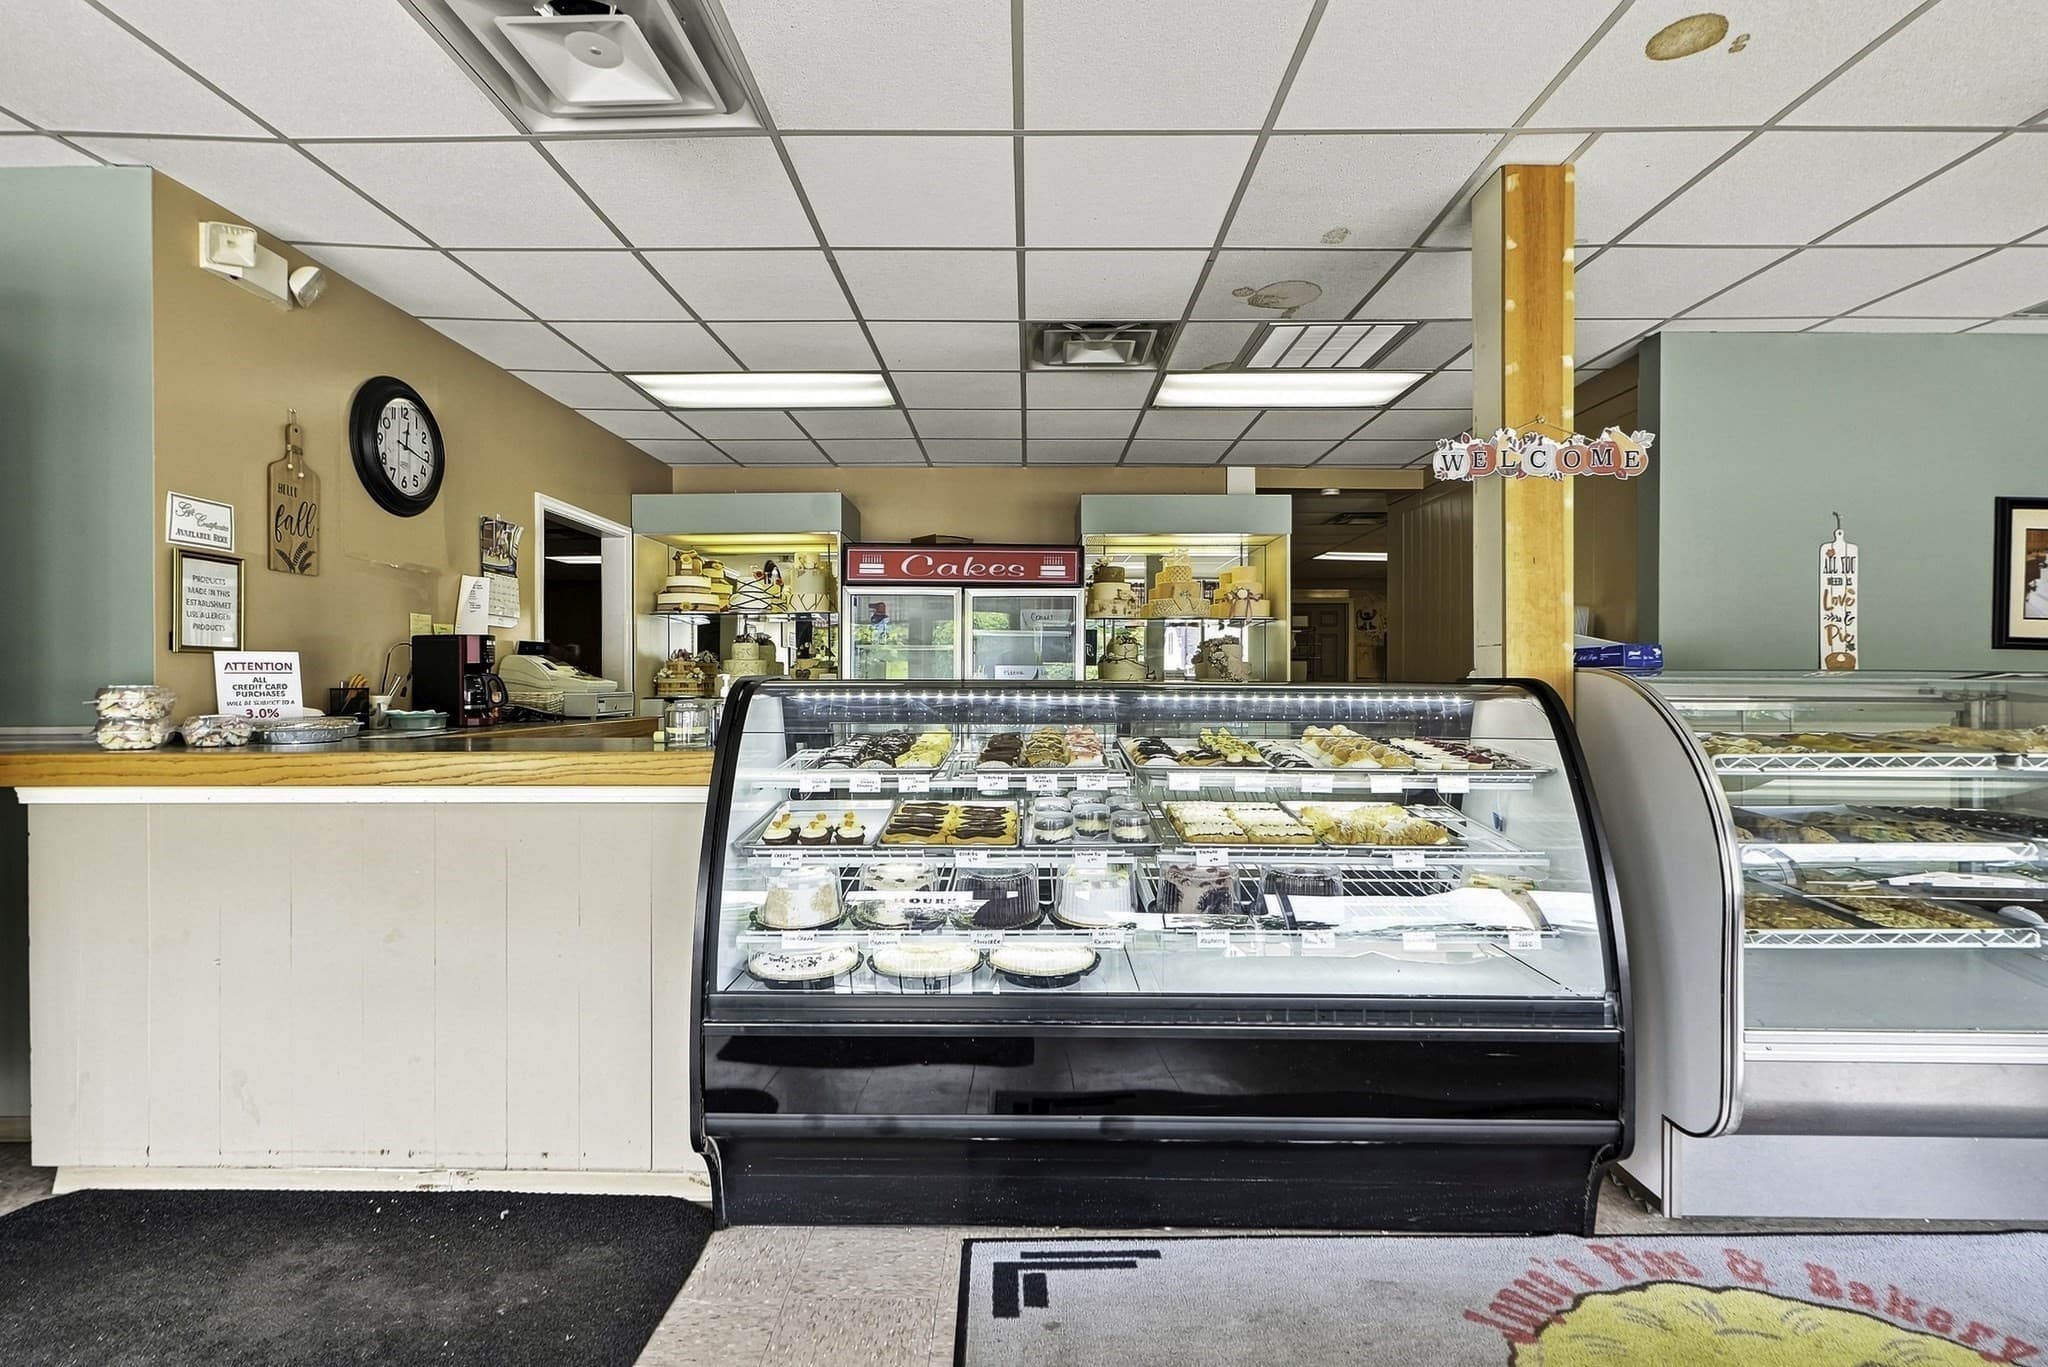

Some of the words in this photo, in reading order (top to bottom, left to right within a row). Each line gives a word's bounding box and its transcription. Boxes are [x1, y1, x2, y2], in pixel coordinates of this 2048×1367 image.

[391, 407, 397, 420] 11
[400, 405, 409, 420] 12
[377, 432, 384, 445] 9
[421, 432, 427, 445] 2
[381, 452, 388, 465] 8
[424, 451, 431, 463] 3
[1441, 447, 1640, 472] WELCOME
[389, 466, 397, 480] 7
[420, 465, 427, 478] 4
[401, 476, 408, 489] 6
[412, 475, 419, 488] 5
[274, 501, 318, 543] fall
[901, 553, 1025, 577] Cakes
[1823, 556, 1839, 574] ALL
[1840, 555, 1857, 574] YOU
[191, 574, 227, 586] PRODUCTS
[187, 586, 208, 596] MADE
[209, 589, 217, 597] IN
[216, 589, 232, 598] THIS
[1823, 589, 1856, 612] Love
[1844, 611, 1856, 626] &
[192, 622, 227, 632] PRODUCTS
[1823, 624, 1855, 646] Pie
[223, 662, 293, 671] ATTENTION
[231, 683, 262, 691] CREDIT
[264, 683, 289, 691] CARD
[235, 690, 286, 698] PURCHASES
[244, 707, 281, 719] 3.0%
[1724, 1248, 1778, 1289] &
[1803, 1261, 2041, 1364] Bakery
